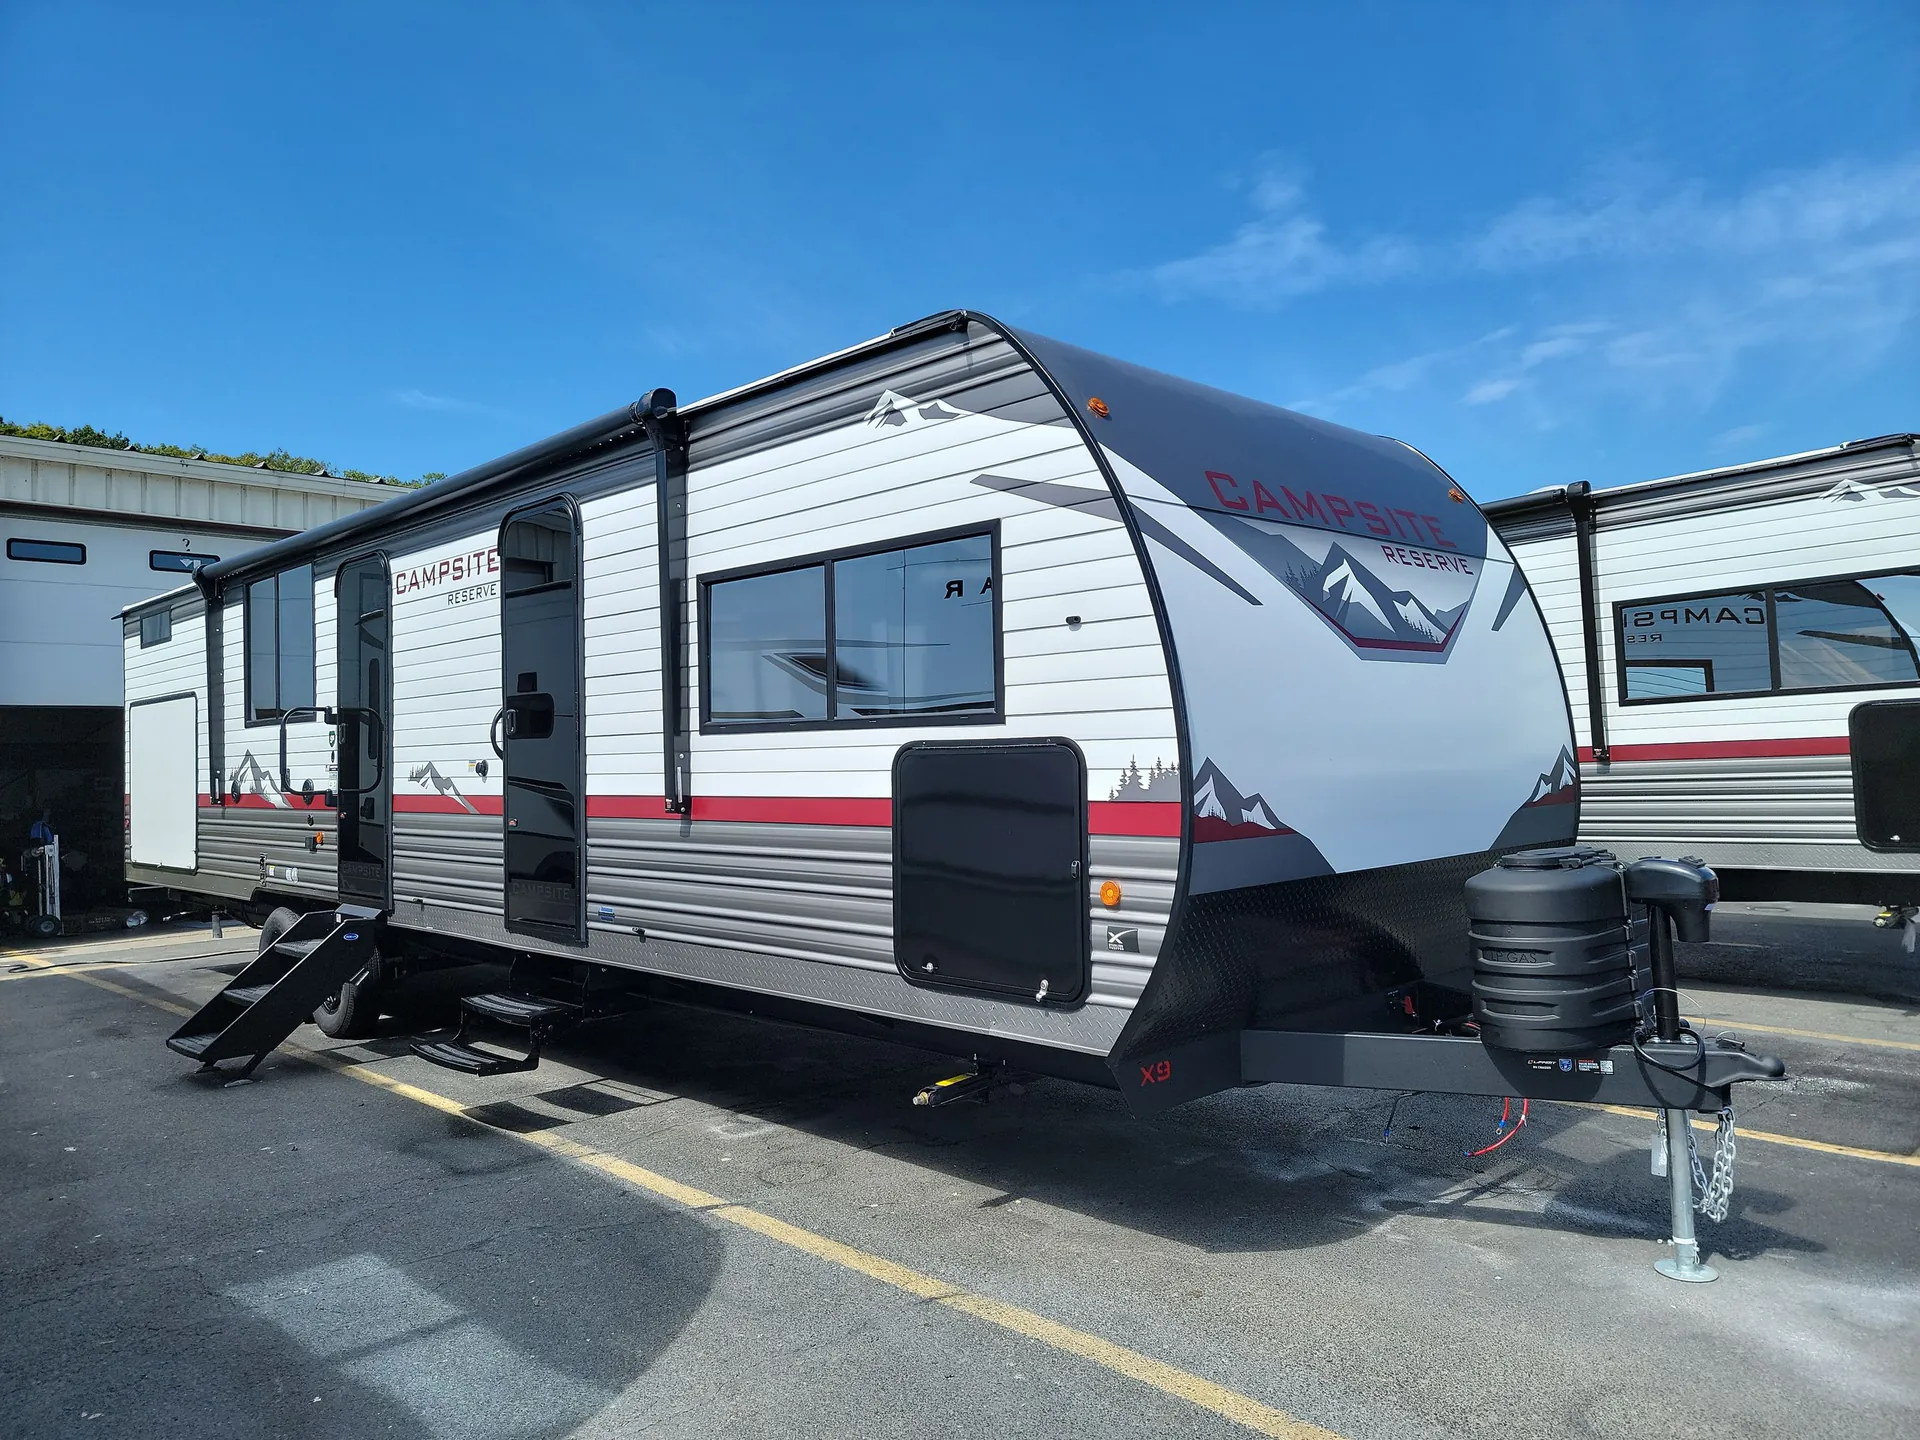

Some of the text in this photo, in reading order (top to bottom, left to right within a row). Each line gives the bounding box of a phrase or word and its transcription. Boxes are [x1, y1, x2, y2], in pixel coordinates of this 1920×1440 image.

[1204, 470, 1457, 548] CAMPSITE
[396, 547, 499, 595] CAMPSITE
[1381, 545, 1474, 575] RESERVE
[447, 583, 497, 606] RESERVE
[1507, 951, 1537, 963] GAS
[1140, 1060, 1172, 1087] X9
